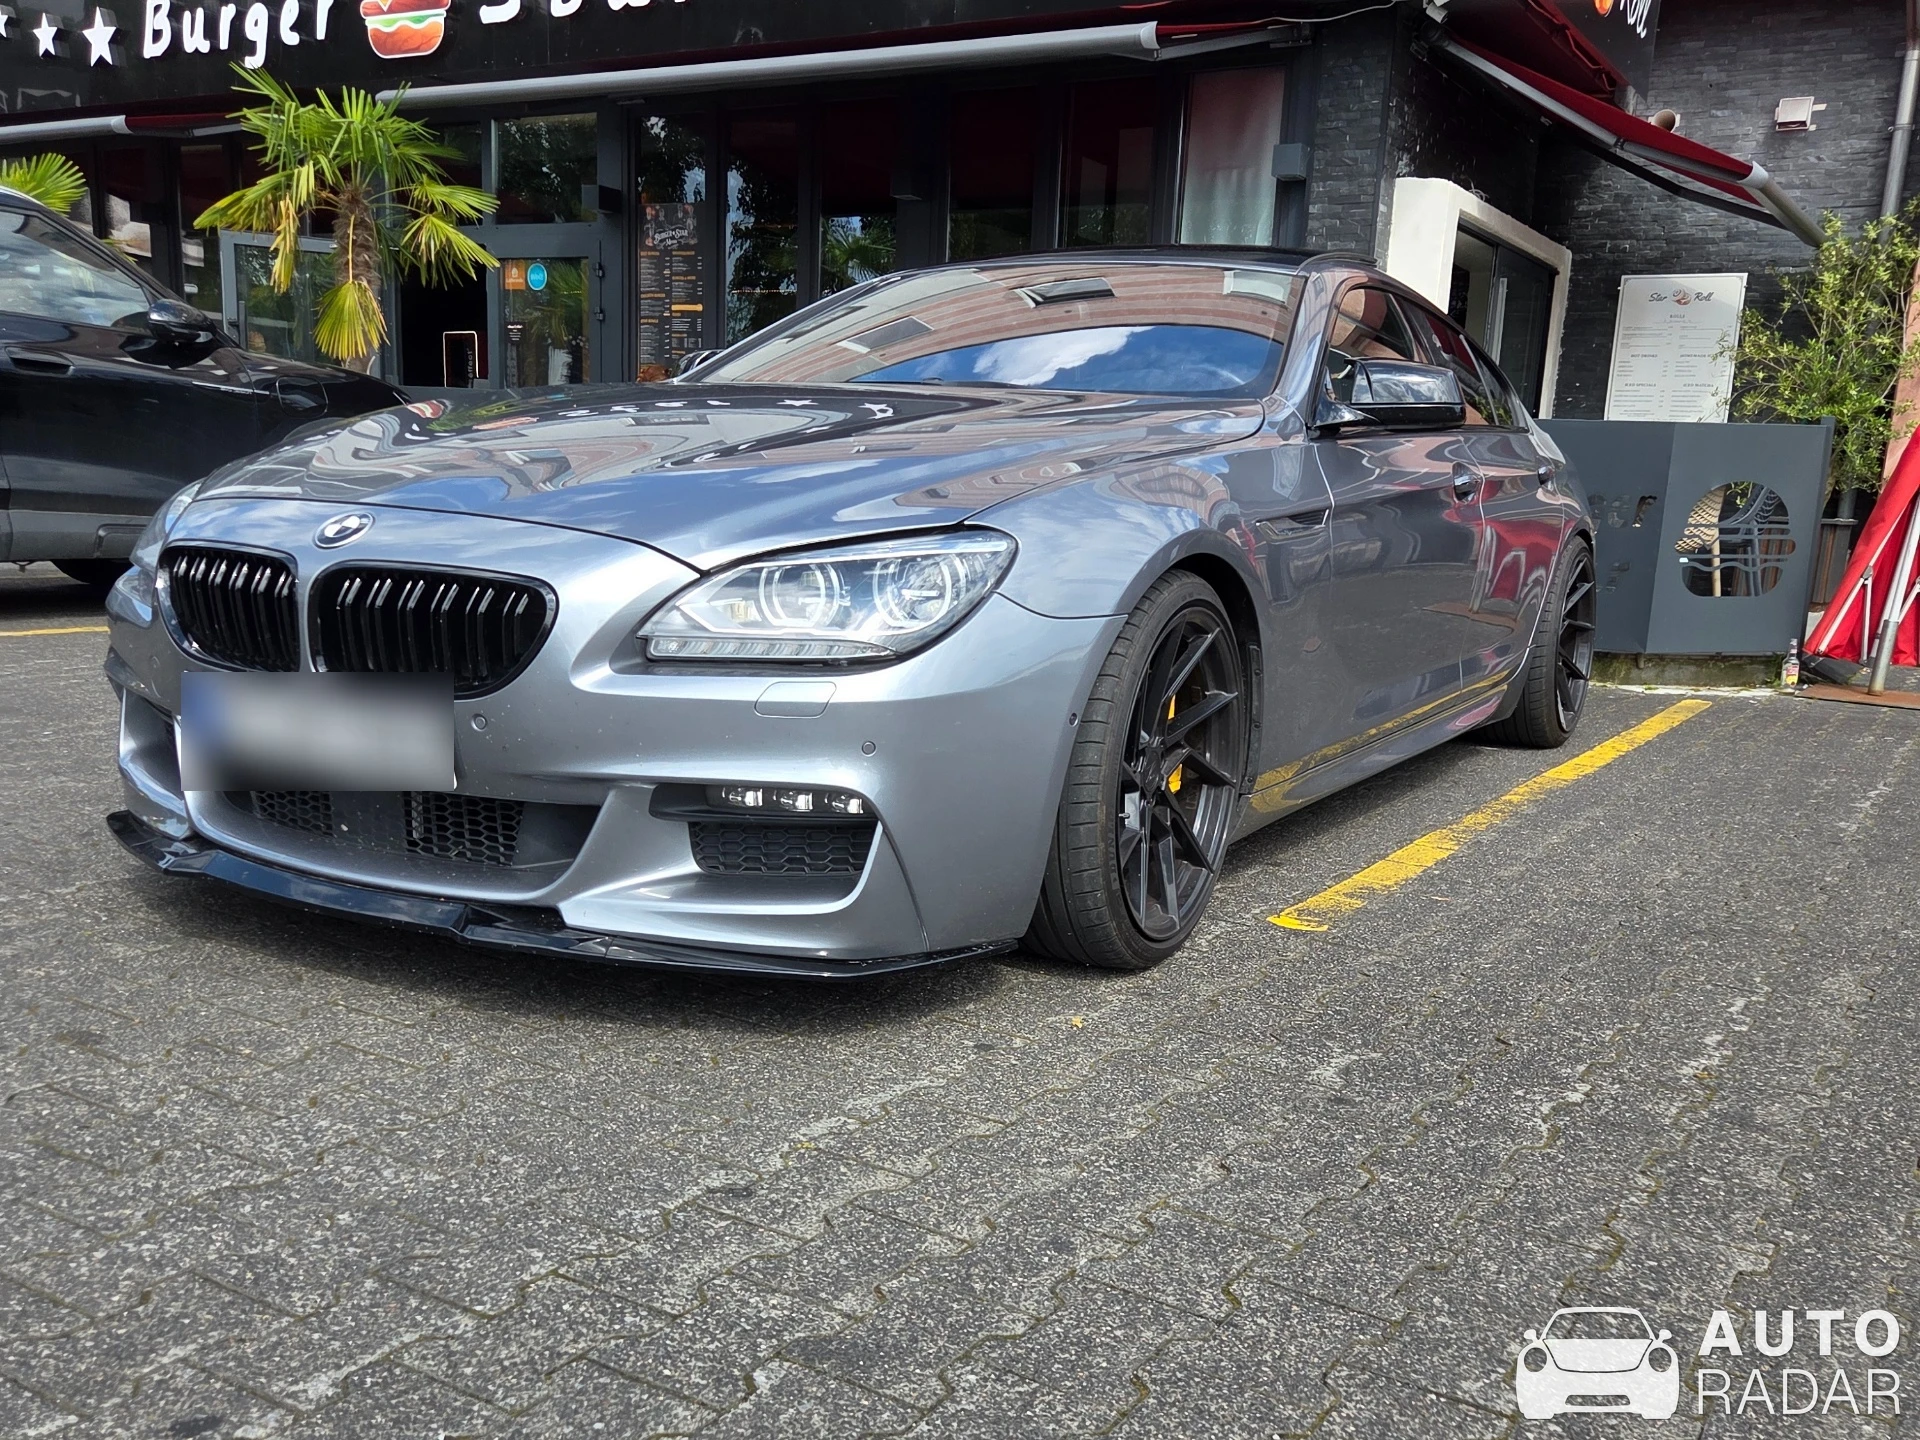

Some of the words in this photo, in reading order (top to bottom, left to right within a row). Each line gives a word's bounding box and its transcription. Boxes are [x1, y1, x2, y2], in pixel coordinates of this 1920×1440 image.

[143, 0, 333, 69] Burger
[1648, 292, 1668, 302] Star
[1693, 291, 1714, 302] Roll
